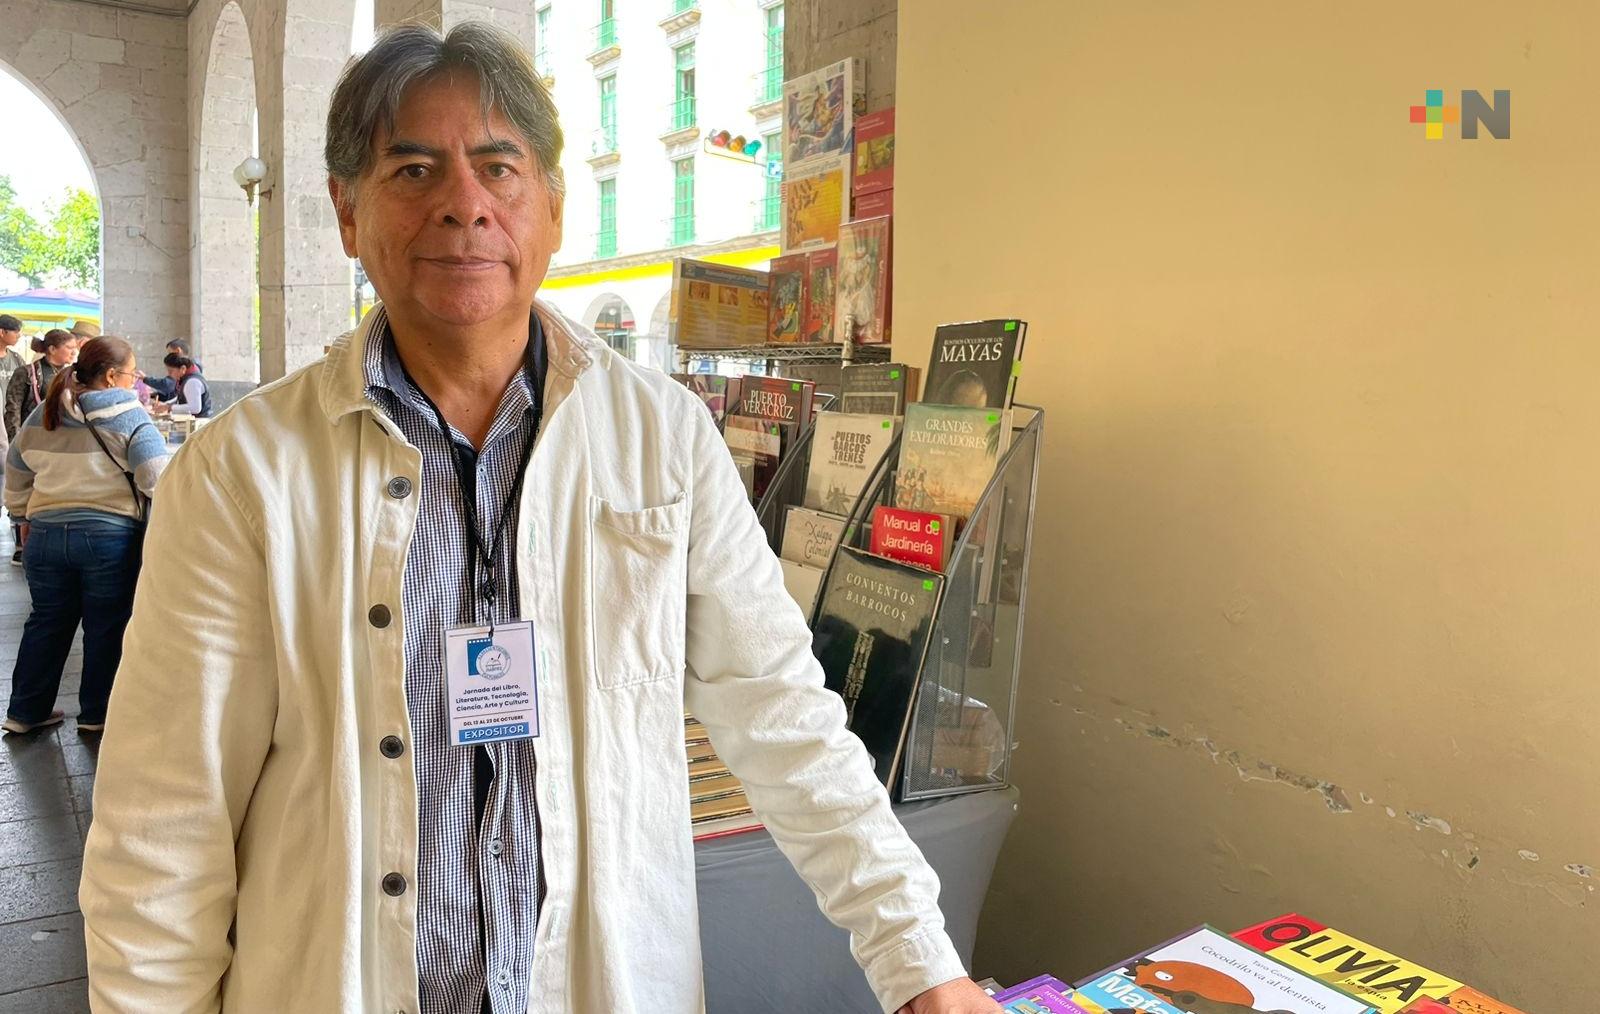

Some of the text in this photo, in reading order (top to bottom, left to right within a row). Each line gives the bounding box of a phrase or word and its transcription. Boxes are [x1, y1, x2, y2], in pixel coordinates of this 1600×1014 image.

[940, 342, 1003, 363] MAYAS
[750, 389, 787, 407] PUERTO
[743, 399, 794, 420] VERACRUZ
[925, 418, 974, 434] GRANDES
[833, 440, 867, 454] BARCOS
[835, 431, 872, 445] PUERTOS
[910, 430, 989, 449] EXPLORADORES
[834, 451, 864, 464] TRENES
[883, 514, 921, 532] Manual
[805, 521, 833, 544] Xalapa
[804, 540, 832, 560] Colonial
[882, 534, 934, 556] Jardinería
[846, 572, 916, 606] CONVENTOS
[846, 590, 908, 622] BARROCOS
[455, 695, 490, 704] Literatura,
[463, 686, 491, 695] Jornada
[484, 701, 498, 709] Arte
[464, 725, 524, 739] EXPOSITOR
[1252, 960, 1269, 971] Taro
[1262, 922, 1427, 1003] OLIVIA
[1201, 946, 1327, 1011] Cocodrilo va al dentista
[1344, 978, 1356, 986] la
